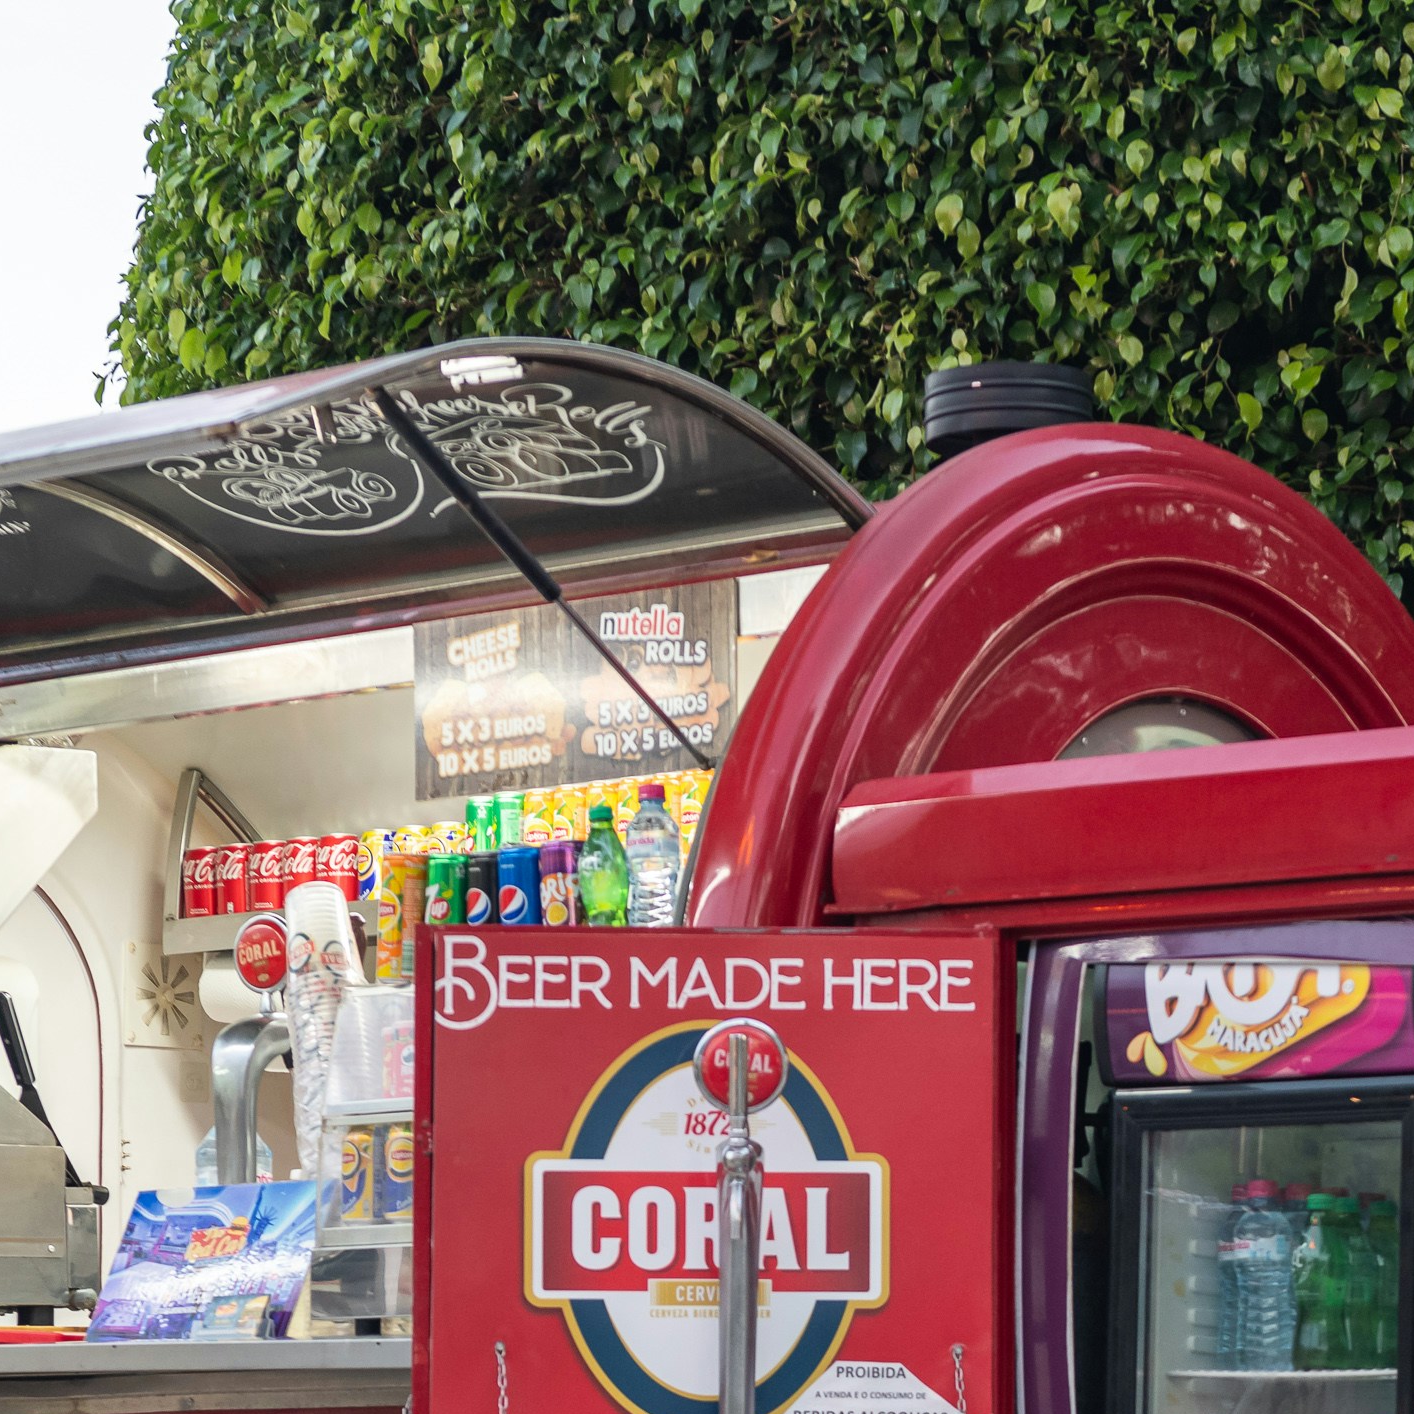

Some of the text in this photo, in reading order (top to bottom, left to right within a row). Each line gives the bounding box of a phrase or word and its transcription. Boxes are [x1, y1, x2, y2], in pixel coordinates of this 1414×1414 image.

[601, 605, 684, 640] nutella
[448, 623, 520, 666] CHEESE
[645, 640, 706, 664] ROLLS
[466, 650, 516, 682] ROLLS
[599, 702, 611, 725] 5
[663, 691, 707, 715] UROS
[441, 723, 453, 746] 5
[478, 717, 490, 740] 3
[494, 715, 546, 740] EUROS
[594, 732, 616, 757] 10
[641, 727, 654, 750] 5
[437, 752, 458, 777] 10
[483, 748, 495, 771] 5
[499, 745, 552, 770] EUROS
[238, 939, 281, 965] CORAL
[435, 935, 975, 1030] BEER MADE HERE
[1206, 995, 1310, 1053] MARACUJÁ
[713, 1048, 774, 1074] CAL
[571, 1185, 851, 1274] CORAL
[675, 1285, 720, 1302] CERV
[836, 1366, 907, 1379] PROIBIDA
[815, 1391, 822, 1399] A
[823, 1391, 852, 1399] VENDA
[915, 1392, 927, 1400] DE
